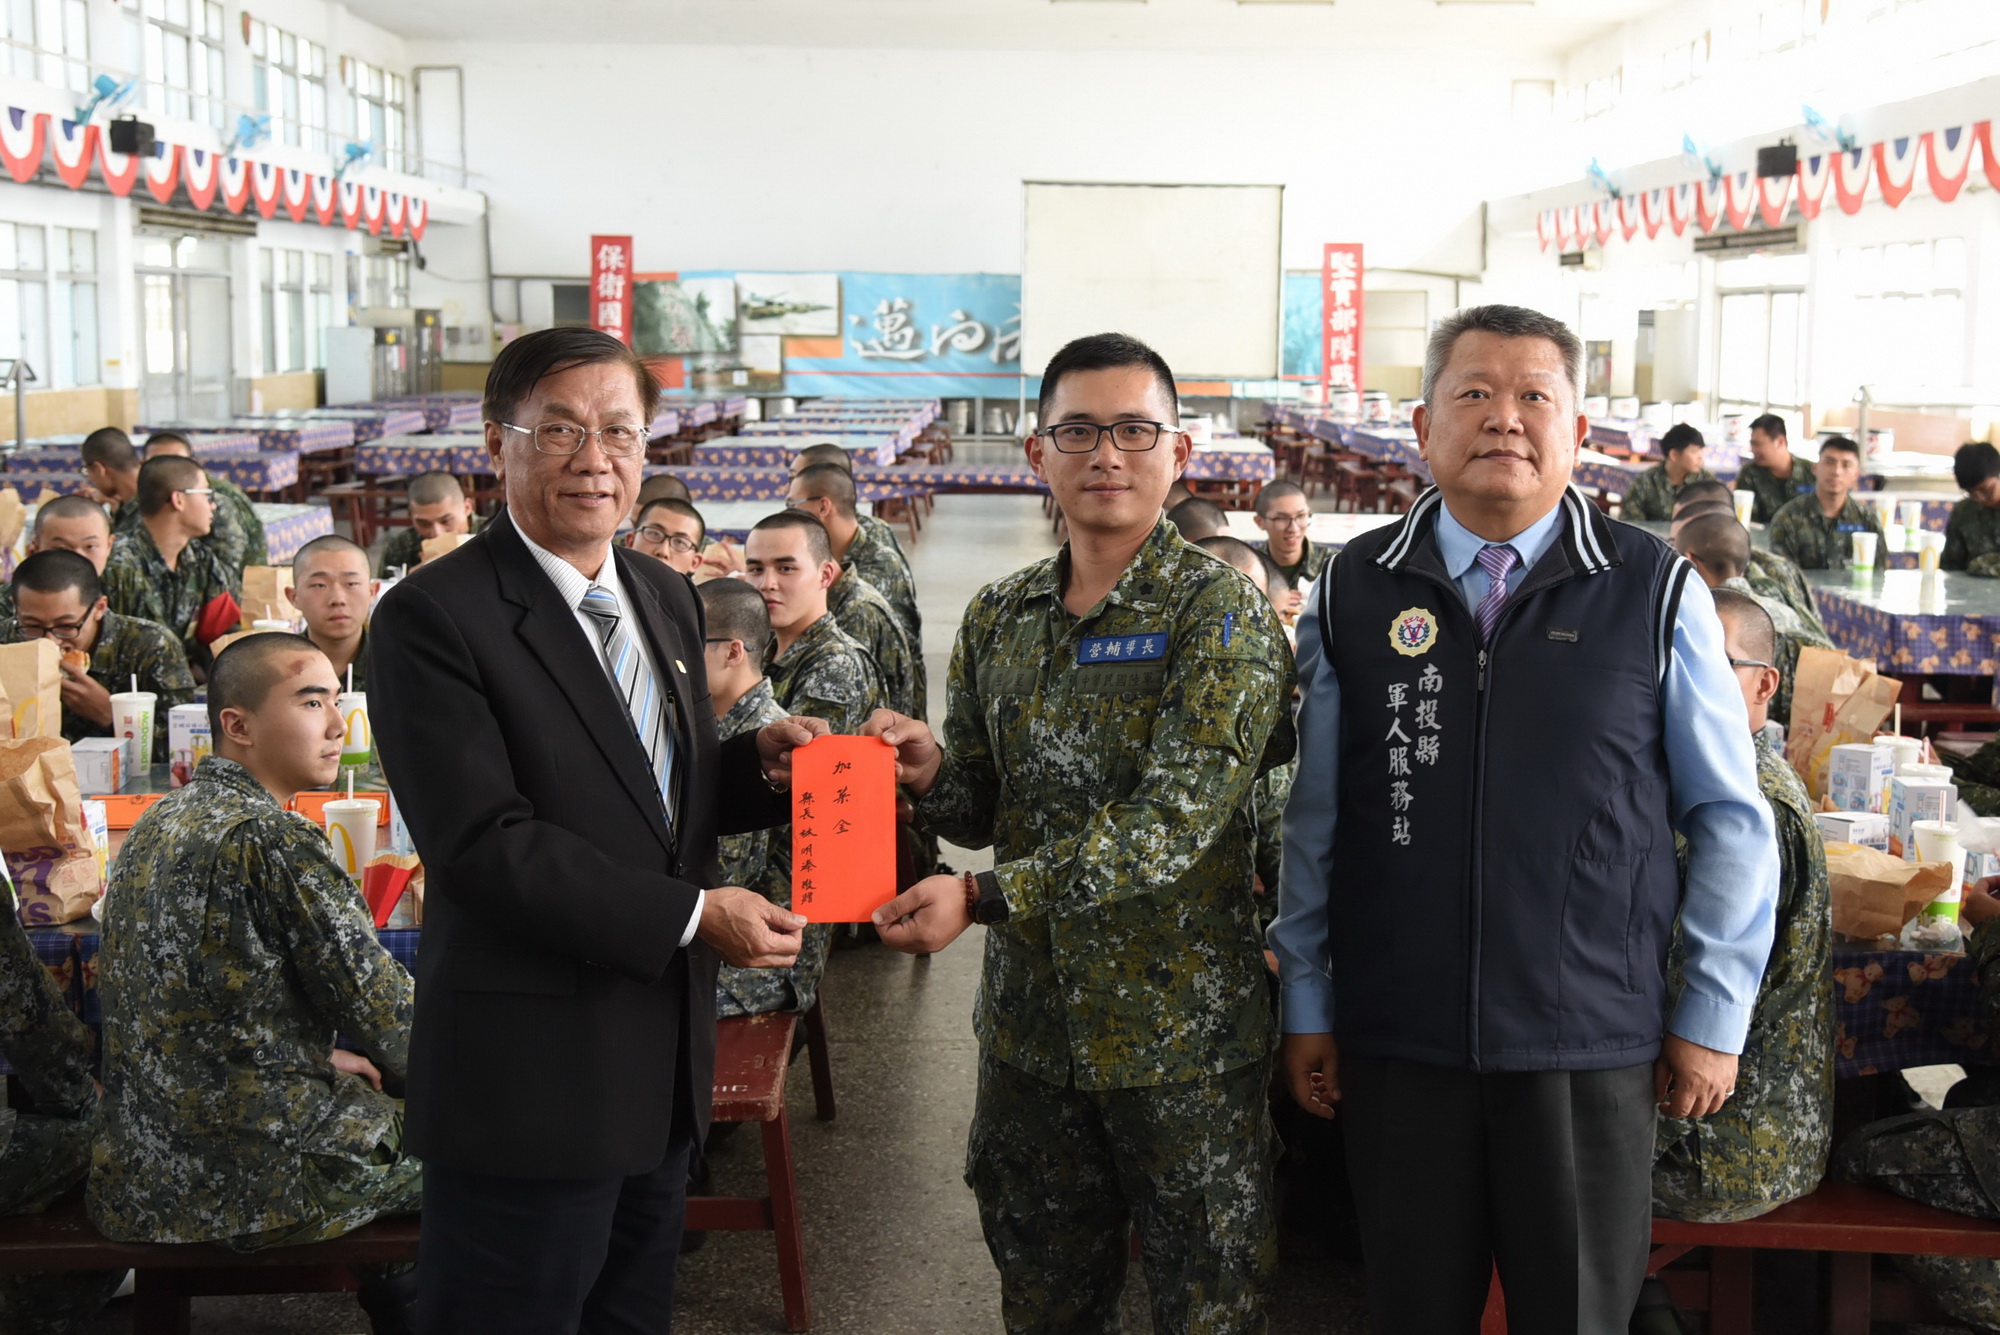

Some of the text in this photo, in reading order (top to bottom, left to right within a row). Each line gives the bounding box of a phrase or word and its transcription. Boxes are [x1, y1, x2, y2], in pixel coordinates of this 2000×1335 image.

[1089, 638, 1155, 658] 營輔導長
[1414, 662, 1443, 766] 南投縣
[832, 760, 852, 835] 加菜金
[1385, 682, 1414, 846] 軍人服務站
